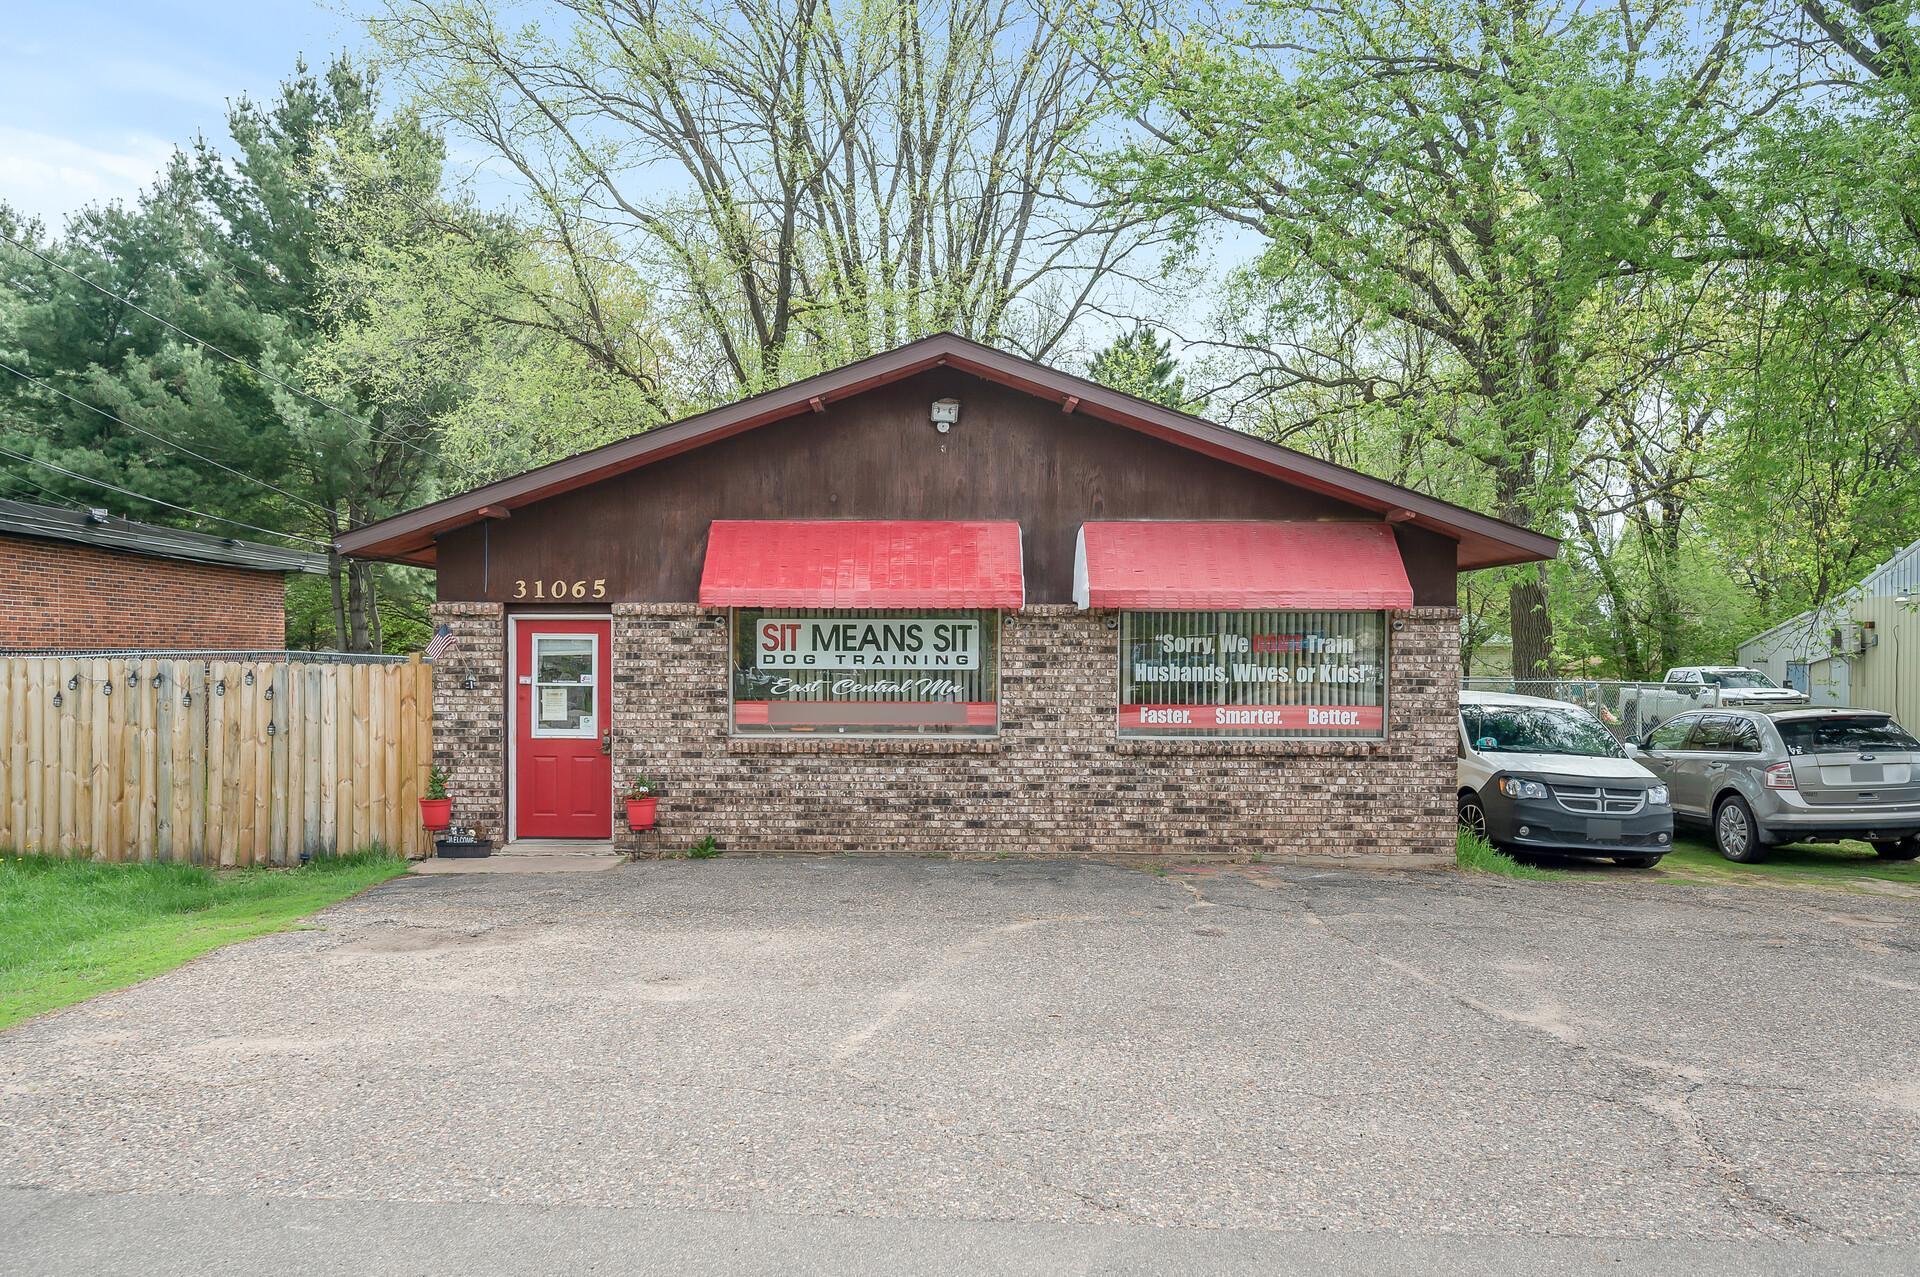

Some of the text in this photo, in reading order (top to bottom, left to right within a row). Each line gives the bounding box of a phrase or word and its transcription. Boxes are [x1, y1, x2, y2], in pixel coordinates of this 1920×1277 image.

[513, 578, 606, 599] 31065
[762, 623, 973, 653] SIT MEANS SIT
[1220, 634, 1249, 654] We
[1306, 634, 1354, 654] Train
[763, 654, 969, 665] DOG TRAINING
[1135, 663, 1229, 684] Husbands,
[1233, 664, 1292, 684] Wives,
[1296, 667, 1316, 683] or
[771, 678, 965, 696] East Central Mn
[1140, 706, 1192, 724] Faster.
[1215, 707, 1283, 725] Smarter.
[1308, 708, 1360, 725] Better.
